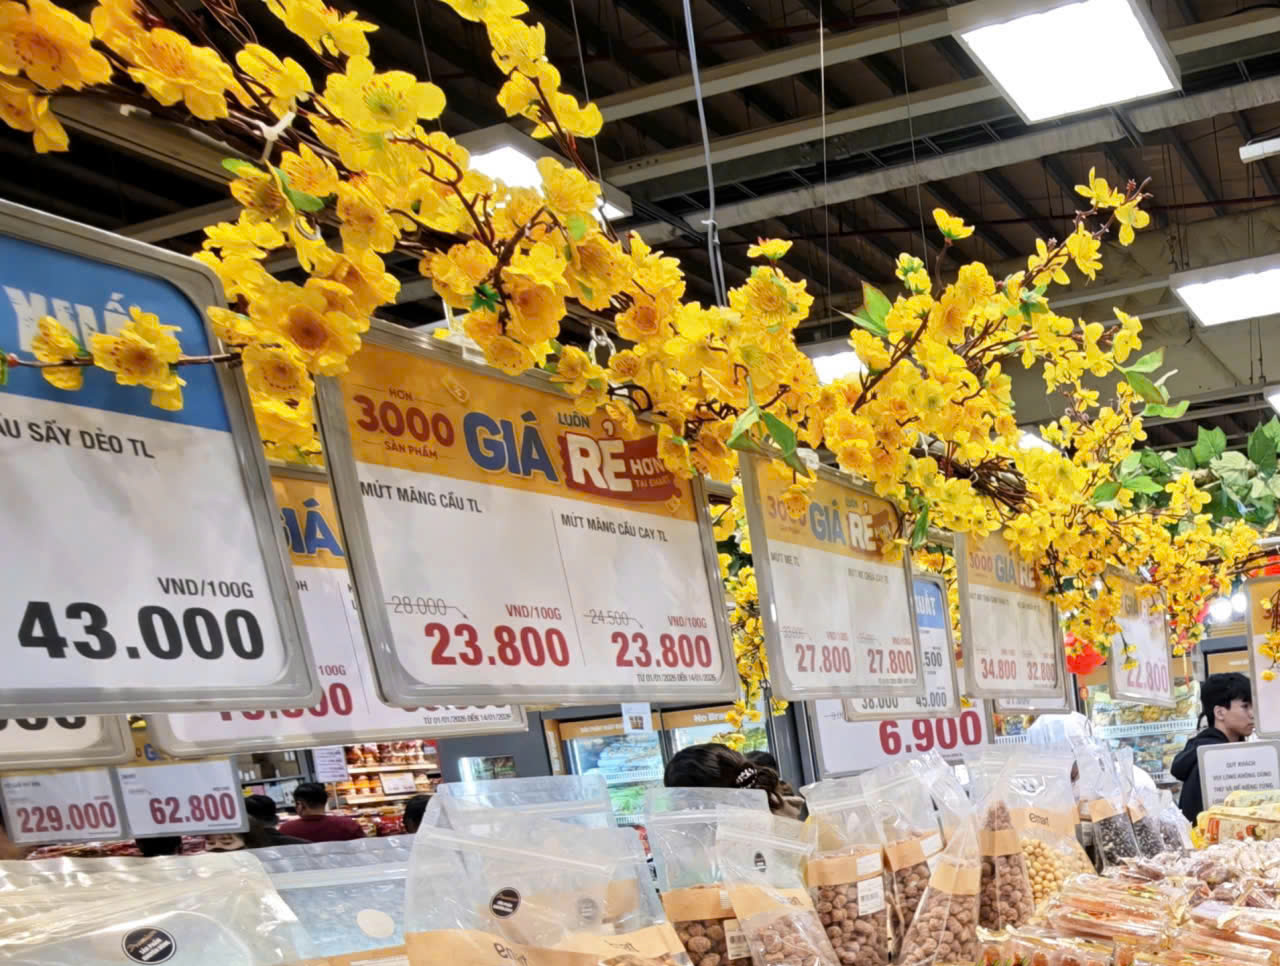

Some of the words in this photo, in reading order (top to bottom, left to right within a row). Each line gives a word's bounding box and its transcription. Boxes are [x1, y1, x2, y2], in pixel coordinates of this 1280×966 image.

[558, 411, 590, 429] LUÔN
[30, 415, 72, 447] SẤY
[80, 427, 124, 454] DẺO
[127, 437, 156, 459] TL
[463, 411, 560, 483] GIÁ
[566, 420, 633, 493] RẺ
[466, 498, 483, 513] TL
[657, 530, 668, 542] TL
[809, 499, 847, 545] GIÁ
[157, 576, 255, 599] VND/100G
[391, 596, 448, 617] 28.000
[505, 604, 562, 621] VND/100G
[17, 601, 265, 660] 43.000
[424, 622, 570, 668] 23.800
[611, 631, 713, 668] 23.800
[795, 644, 852, 673] 27.800
[867, 648, 914, 675] 27.800
[879, 710, 983, 756] 6.900
[16, 801, 117, 834] 229.000
[149, 793, 237, 825] 62.800
